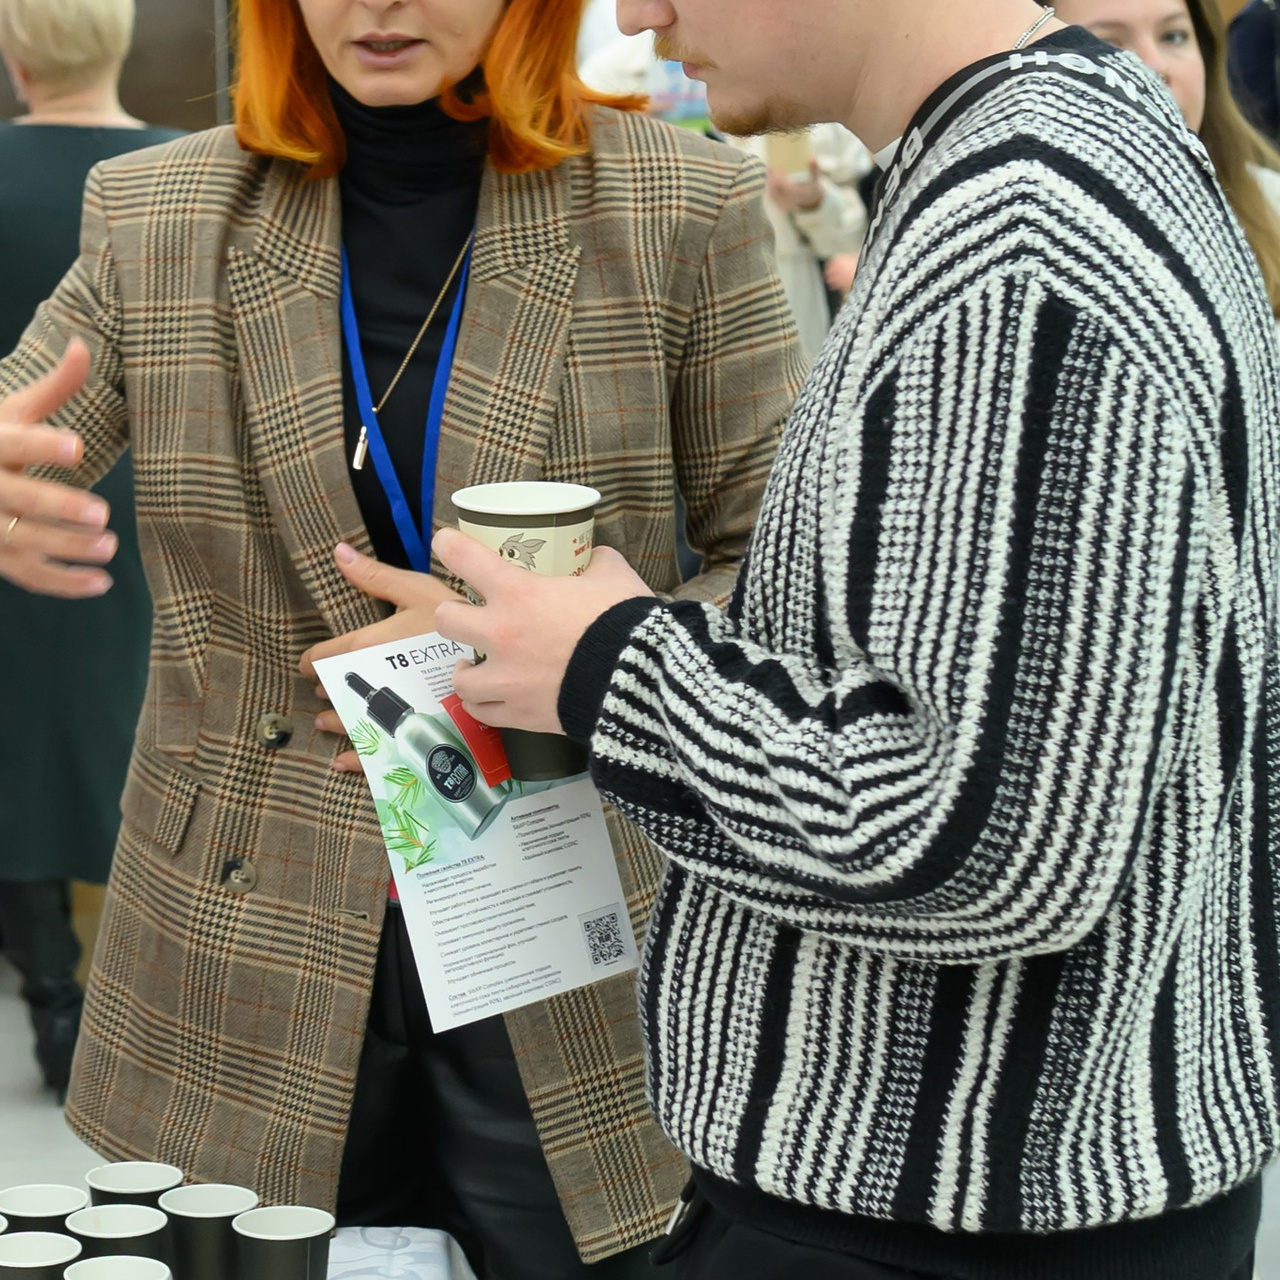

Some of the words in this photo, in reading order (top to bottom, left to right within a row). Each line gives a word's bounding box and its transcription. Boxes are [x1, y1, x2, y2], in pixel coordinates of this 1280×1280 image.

[385, 653, 409, 670] T8
[409, 640, 465, 665] EXTRA
[443, 776, 455, 790] T8
